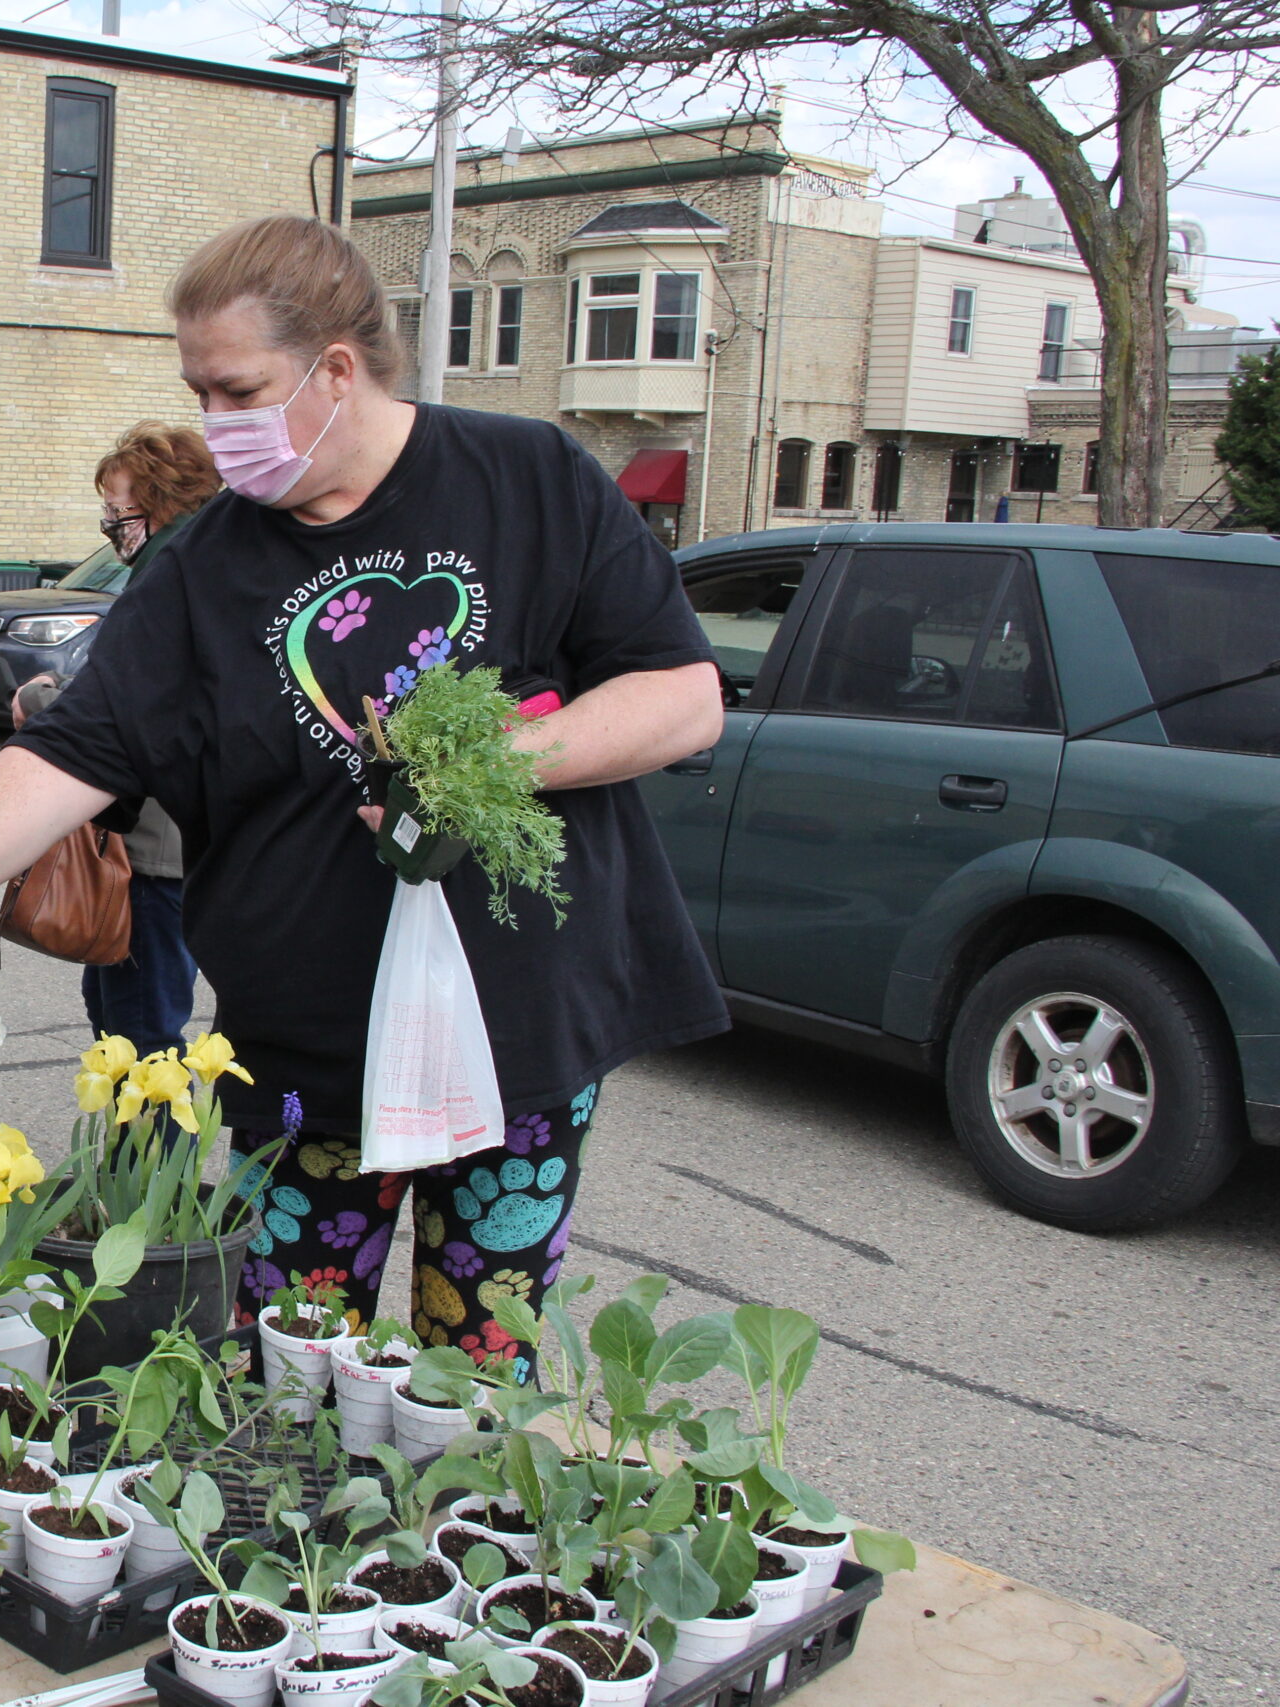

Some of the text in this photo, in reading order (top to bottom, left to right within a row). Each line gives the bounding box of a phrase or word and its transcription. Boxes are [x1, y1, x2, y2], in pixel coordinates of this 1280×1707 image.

[354, 549, 406, 572] with
[426, 550, 477, 576] paw
[282, 556, 348, 613] paved
[266, 616, 289, 632] is
[460, 582, 493, 653] prints
[264, 633, 293, 695] heart
[310, 723, 334, 748] to
